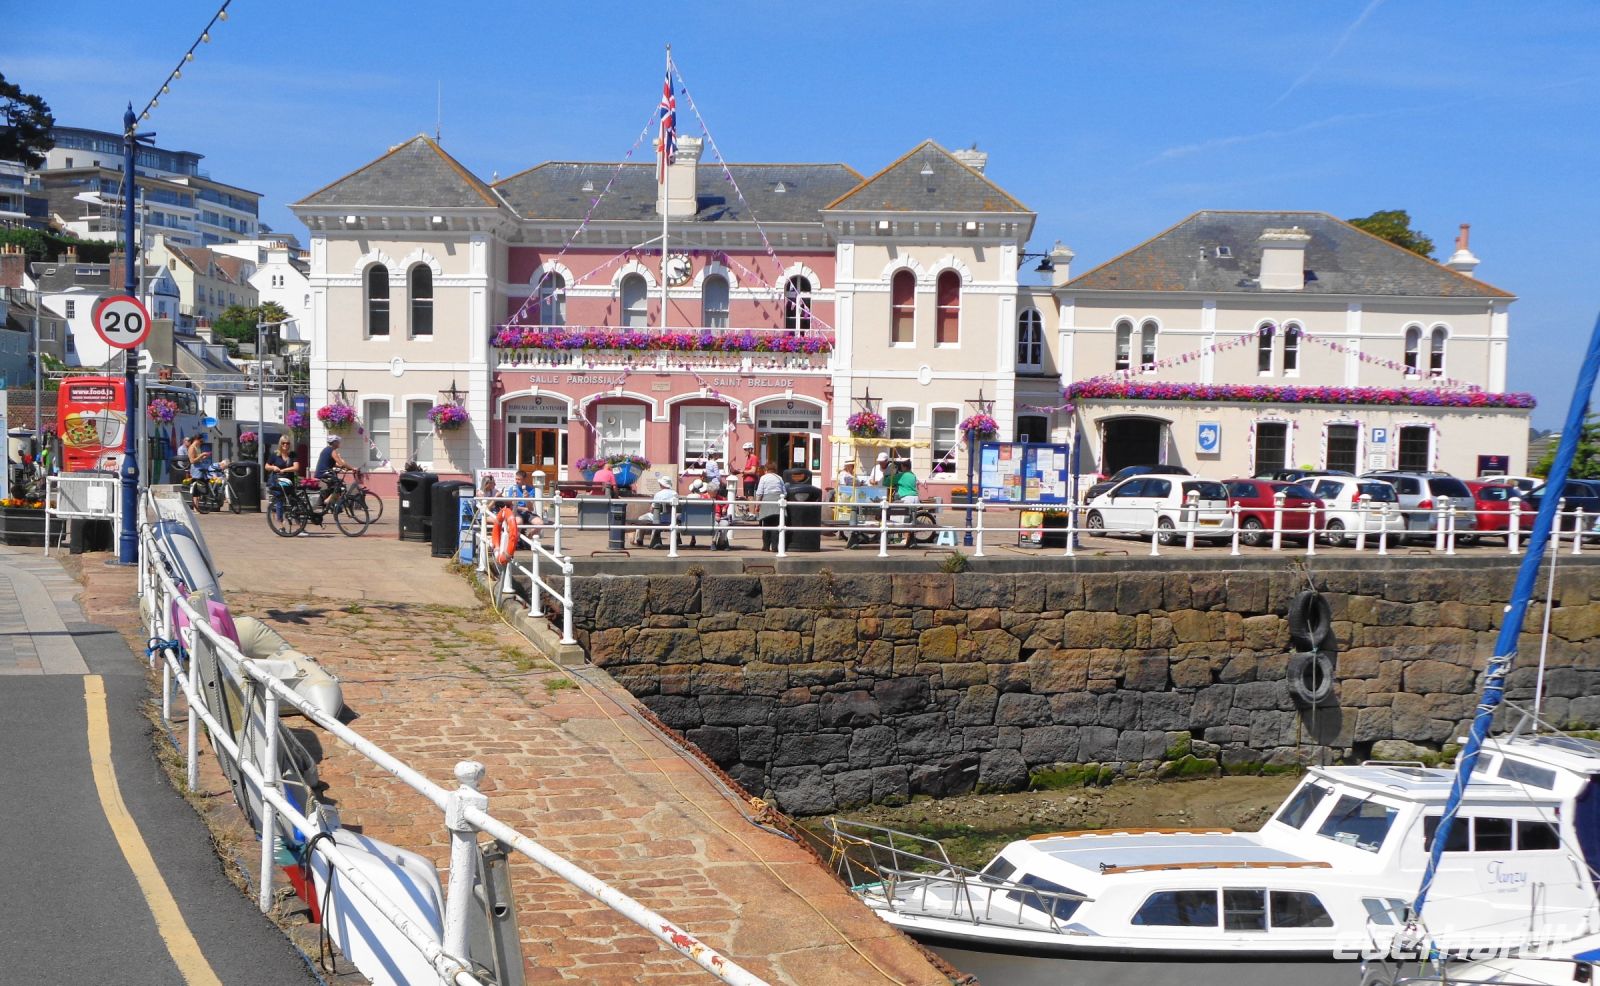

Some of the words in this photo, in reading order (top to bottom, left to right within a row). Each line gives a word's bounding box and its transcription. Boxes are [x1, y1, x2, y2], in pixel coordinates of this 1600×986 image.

[104, 311, 142, 333] 20
[529, 375, 559, 384] SALLE
[713, 378, 741, 387] SAINT
[748, 378, 794, 388] BRELADE
[1374, 430, 1385, 442] P
